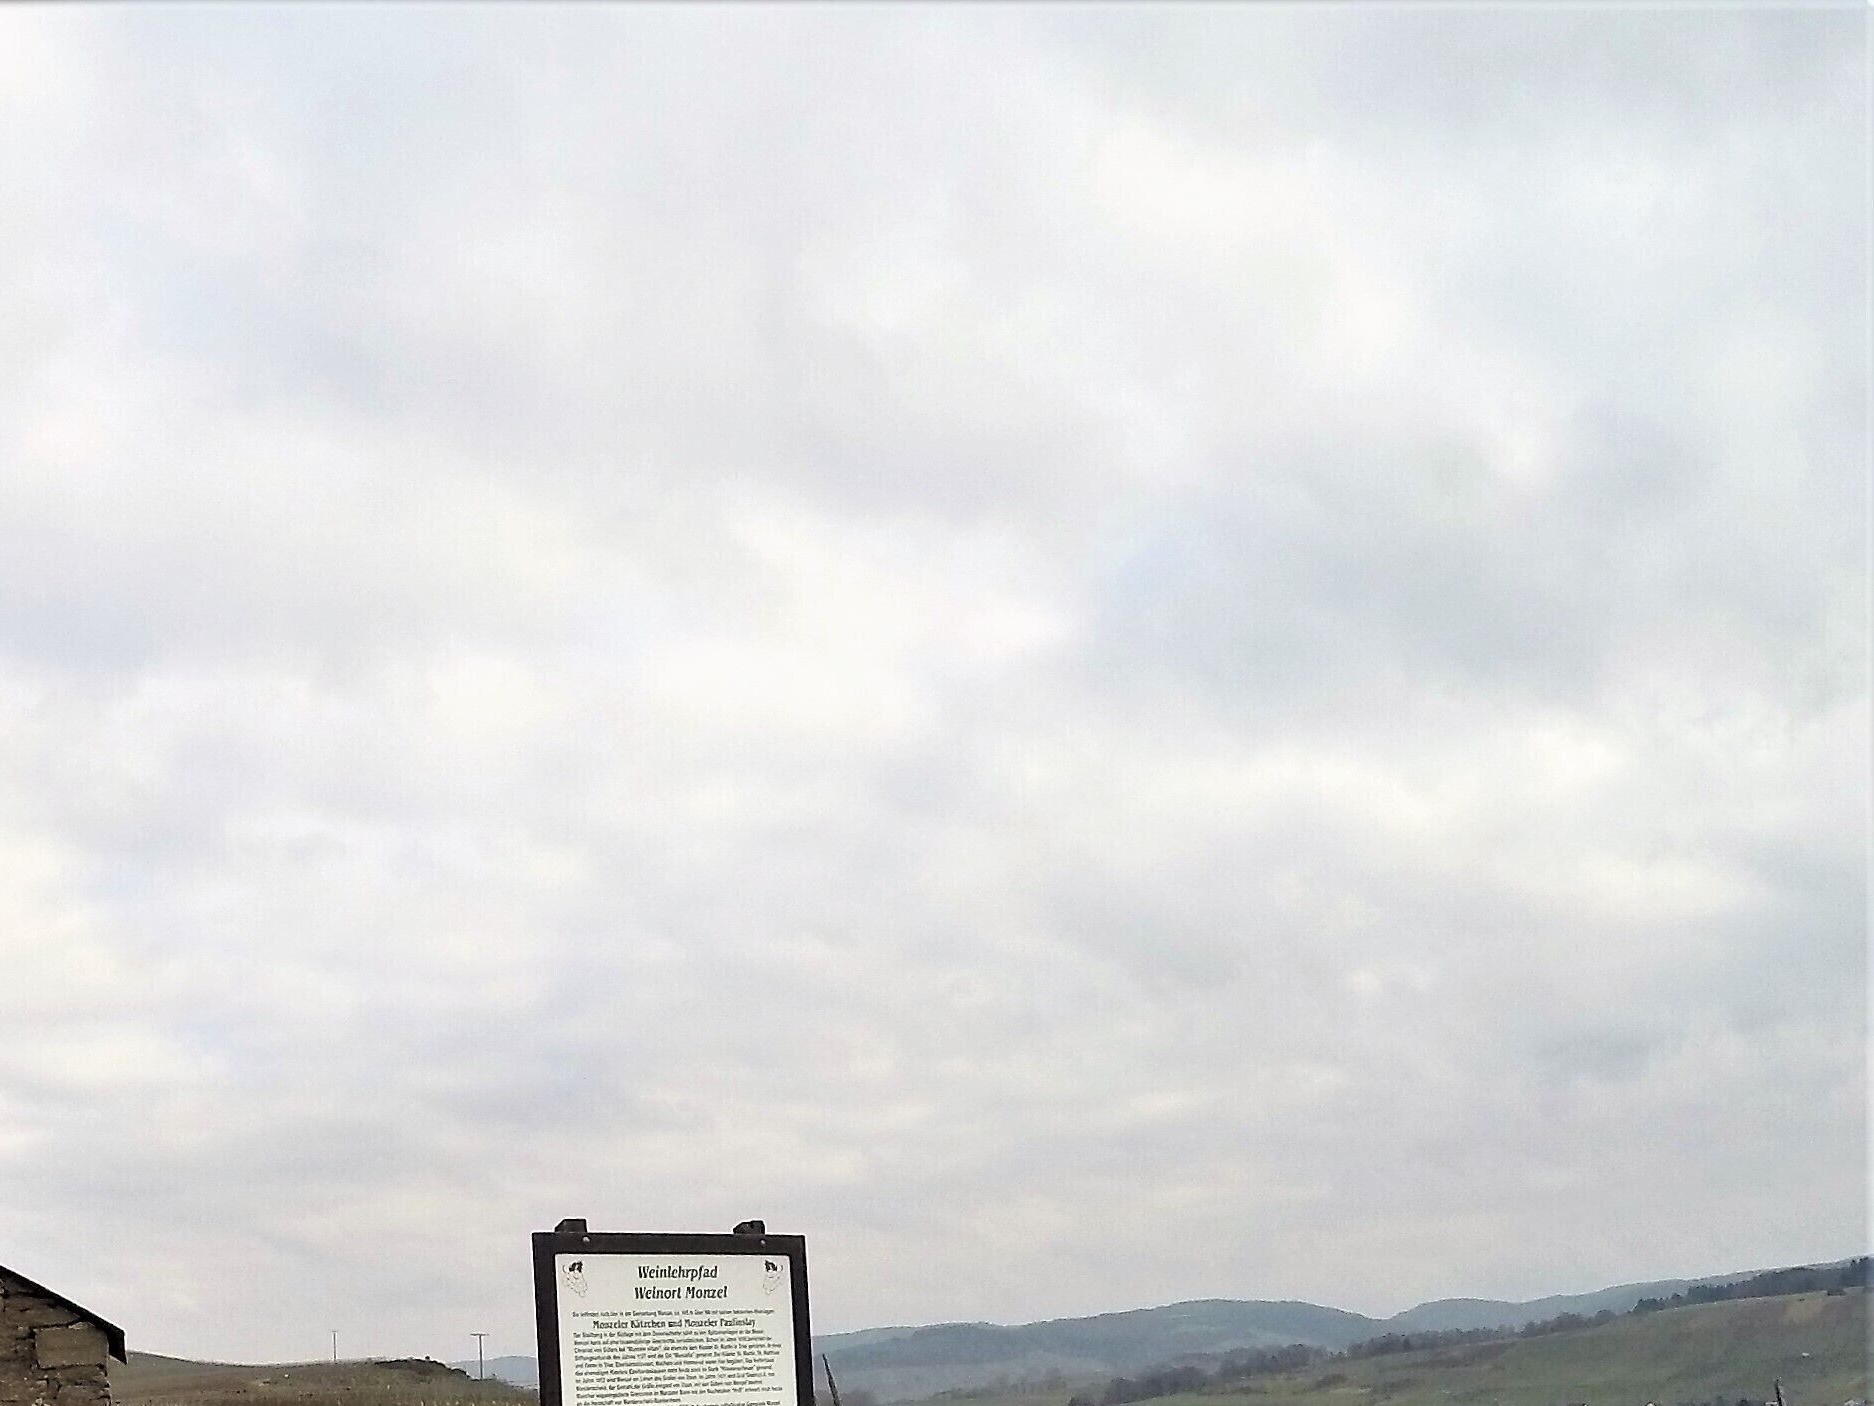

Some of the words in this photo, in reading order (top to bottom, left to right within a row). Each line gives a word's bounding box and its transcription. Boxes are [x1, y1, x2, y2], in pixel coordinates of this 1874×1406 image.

[638, 1265, 718, 1281] Weinlehrpfad
[635, 1286, 681, 1299] Weinort
[686, 1285, 727, 1299] Monzel
